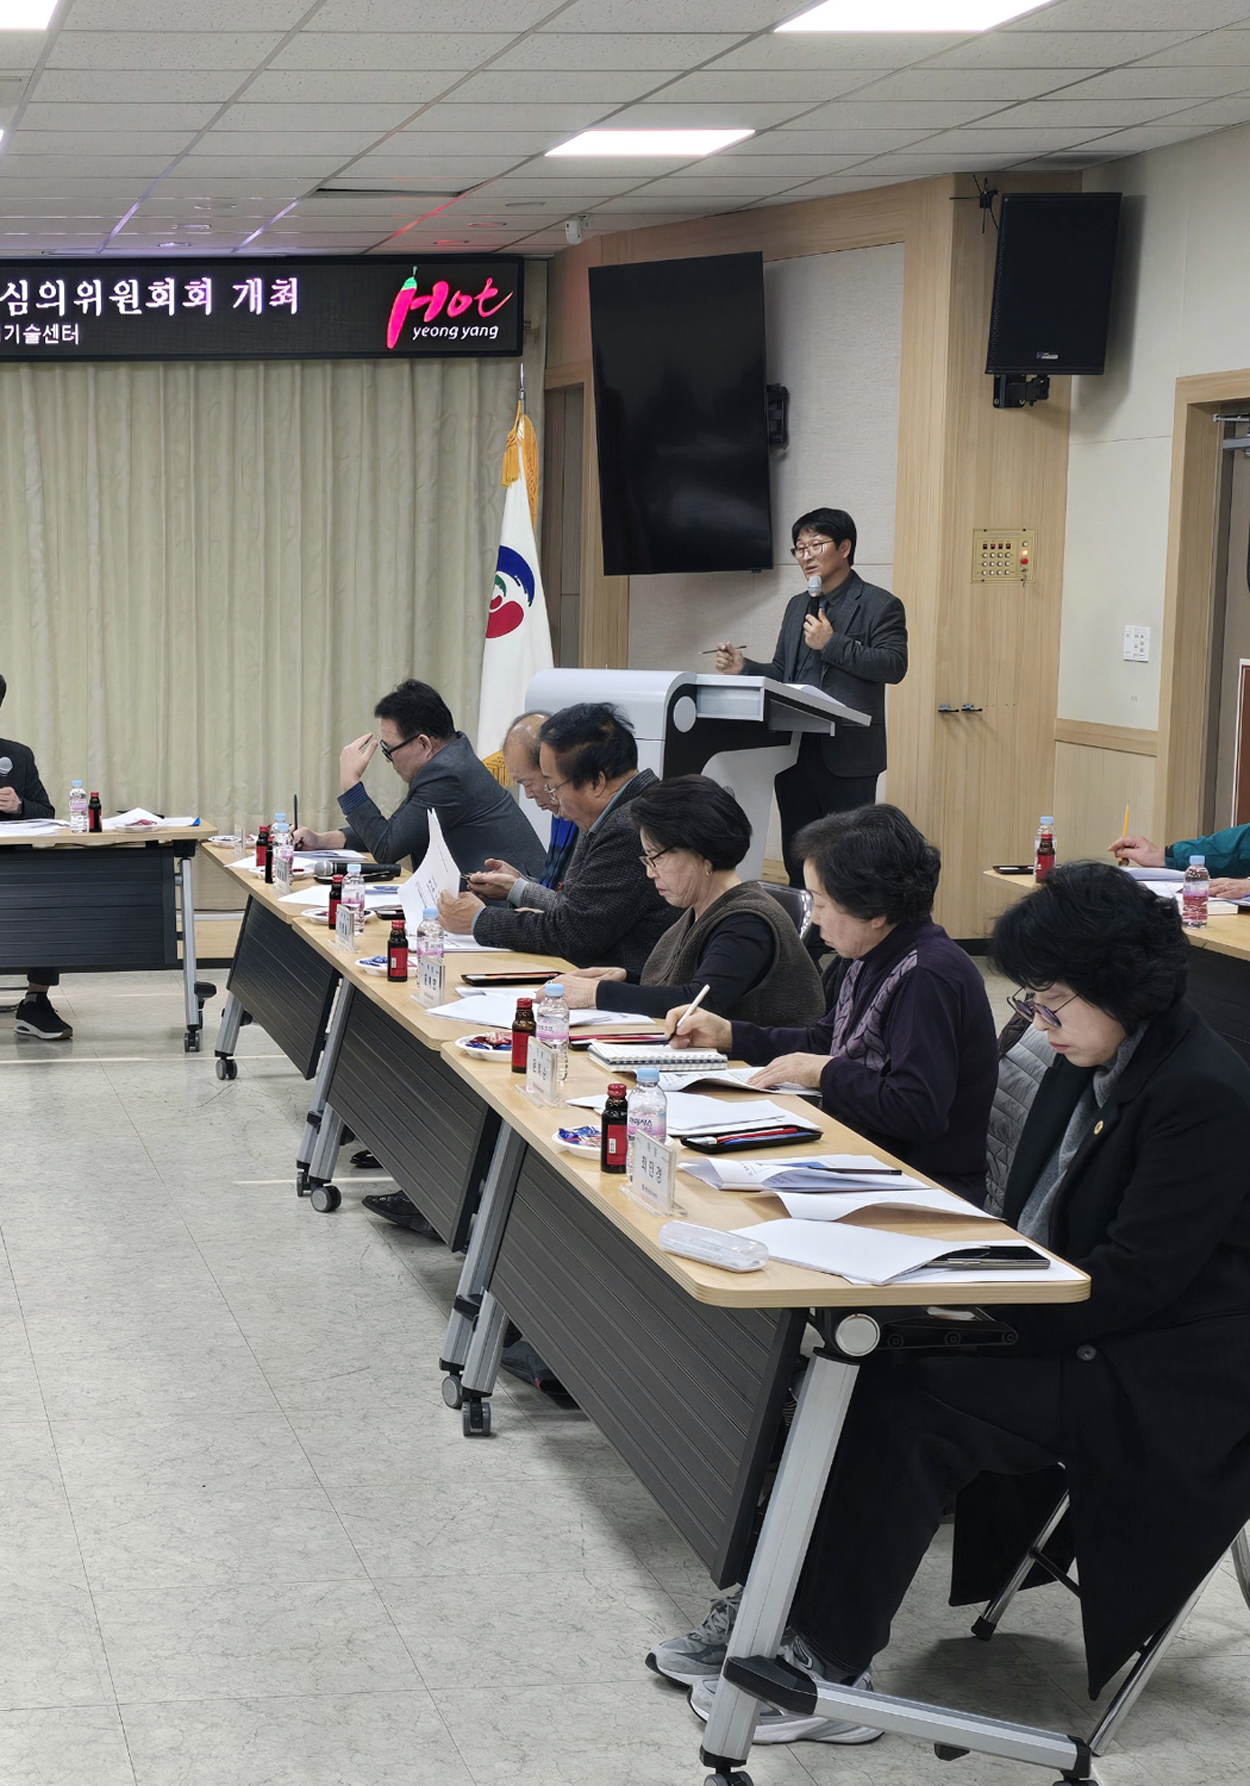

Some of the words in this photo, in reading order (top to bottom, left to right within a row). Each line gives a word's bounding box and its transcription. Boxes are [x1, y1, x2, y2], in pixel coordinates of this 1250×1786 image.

[232, 277, 298, 315] 개최
[386, 265, 513, 350] Hot
[412, 326, 458, 341] yeong
[460, 326, 499, 340] yang
